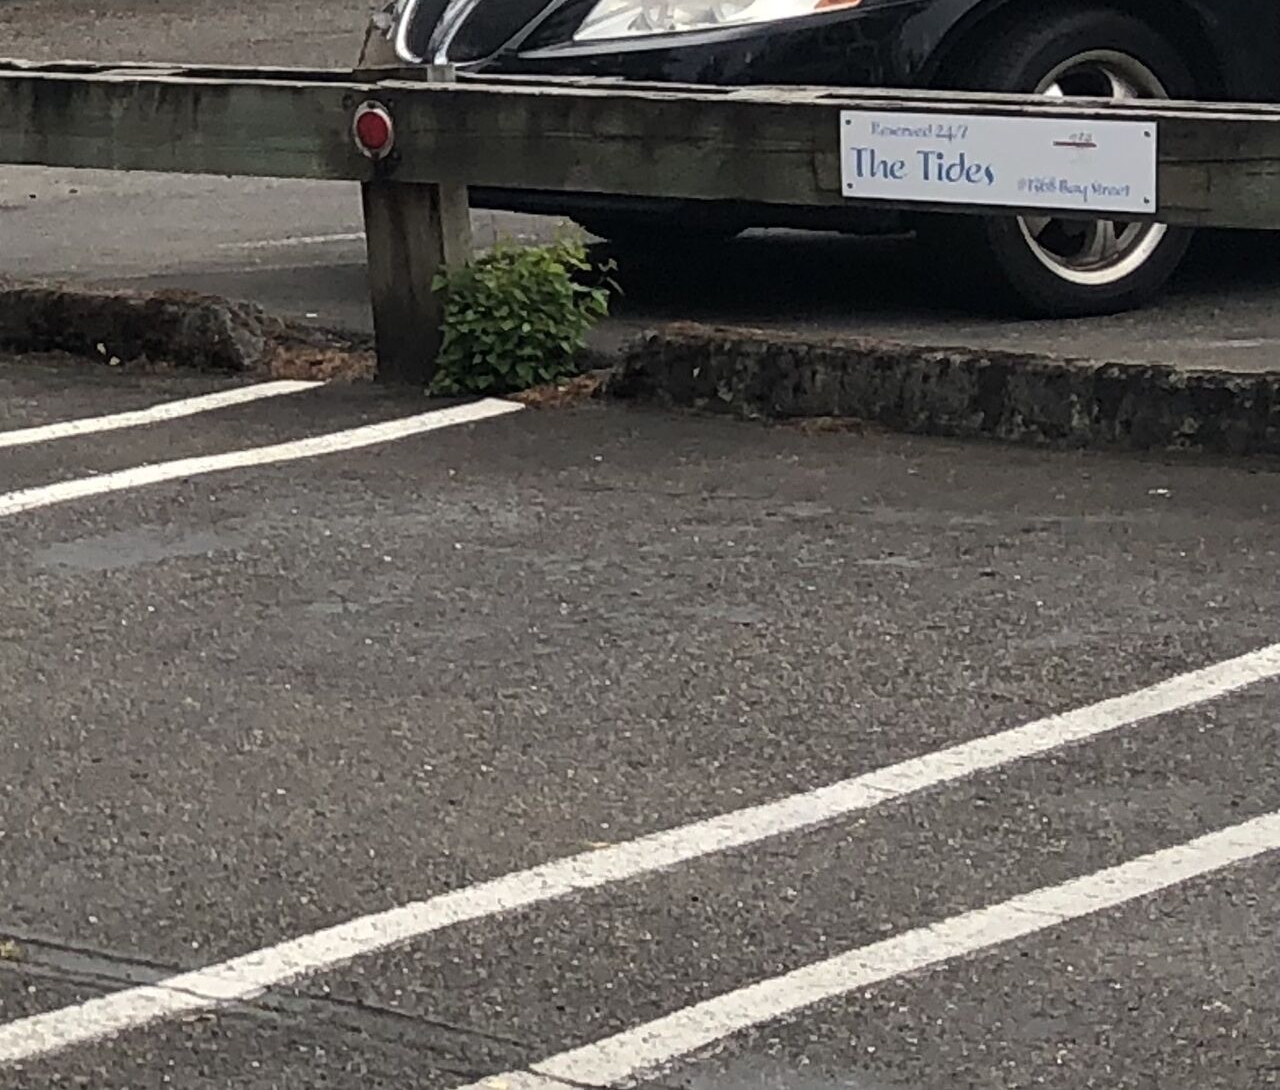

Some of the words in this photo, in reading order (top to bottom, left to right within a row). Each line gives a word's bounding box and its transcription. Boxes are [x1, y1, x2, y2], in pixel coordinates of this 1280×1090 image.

[871, 121, 932, 137] Reserved
[850, 146, 908, 180] The
[916, 150, 995, 186] Tides
